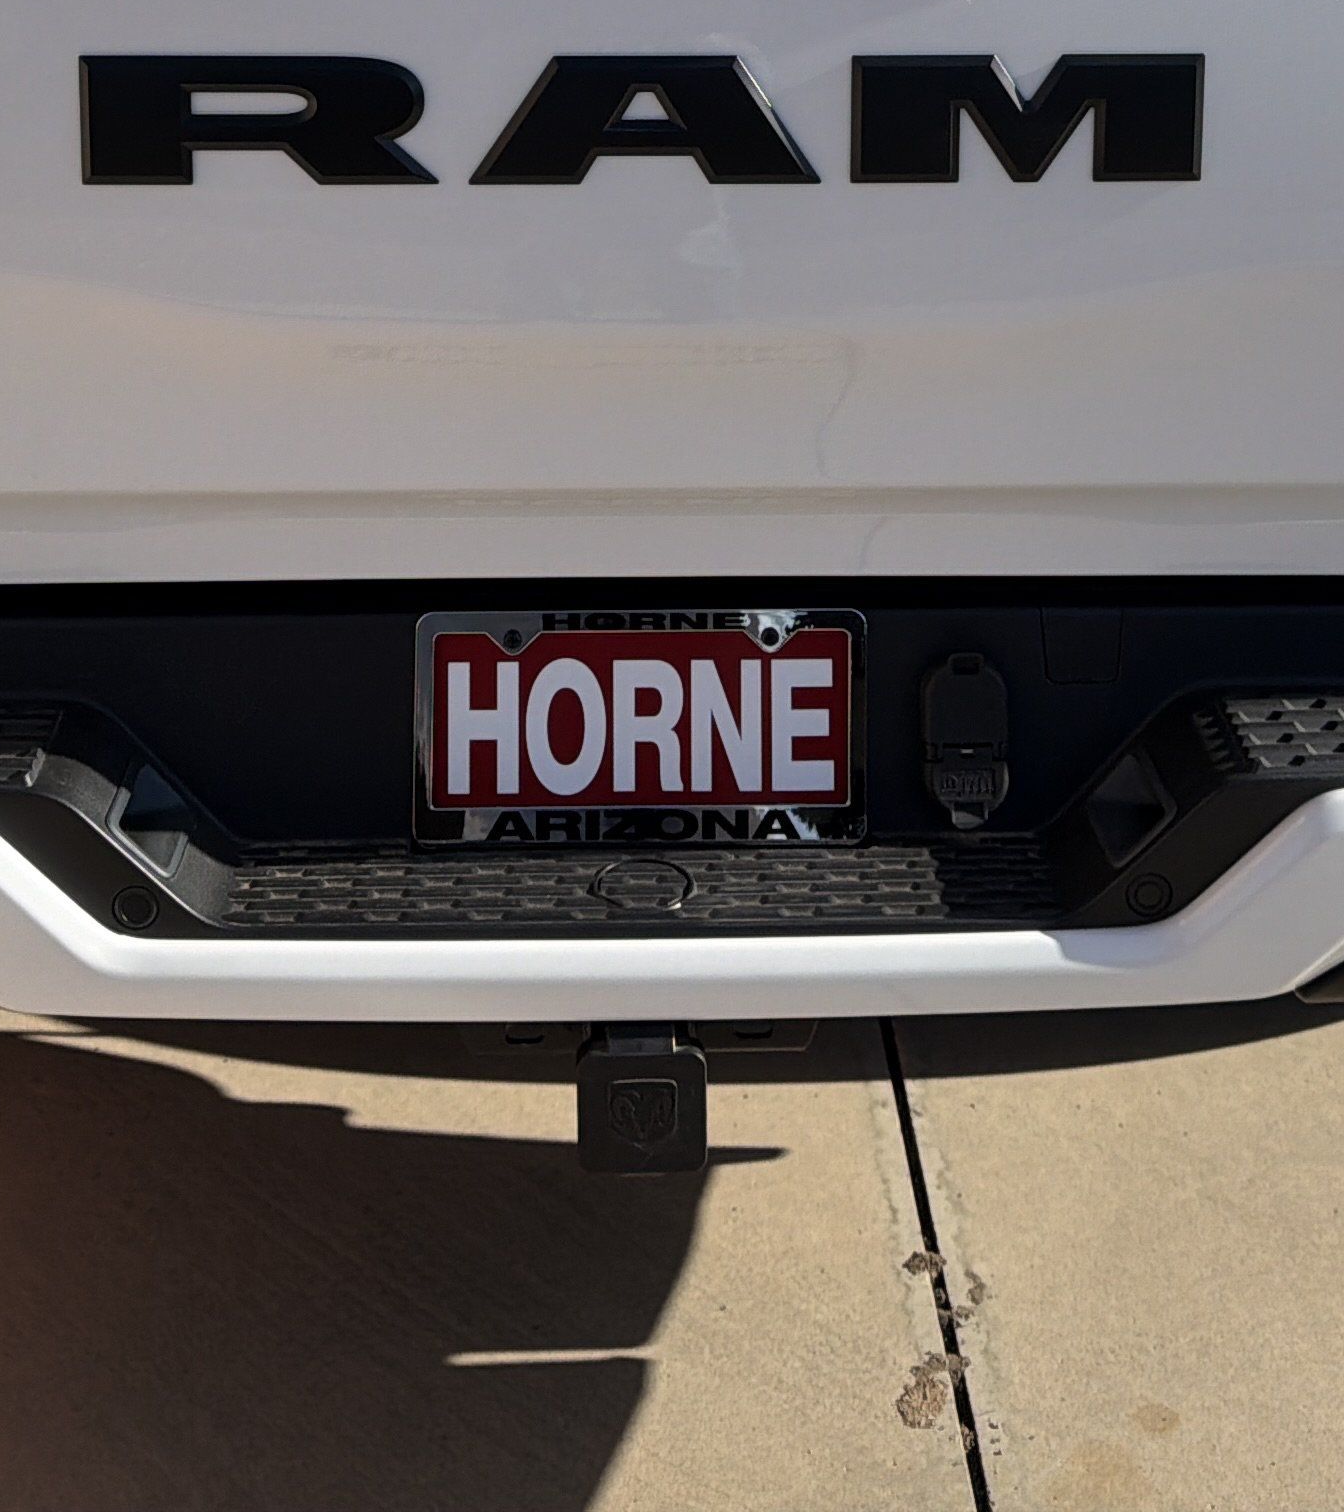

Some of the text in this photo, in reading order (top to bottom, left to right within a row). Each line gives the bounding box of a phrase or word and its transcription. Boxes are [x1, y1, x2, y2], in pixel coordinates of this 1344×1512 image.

[79, 54, 1205, 185] RAM
[542, 613, 747, 630] HORNE
[447, 657, 835, 795] HORNE
[485, 810, 803, 841] ARIZONA
